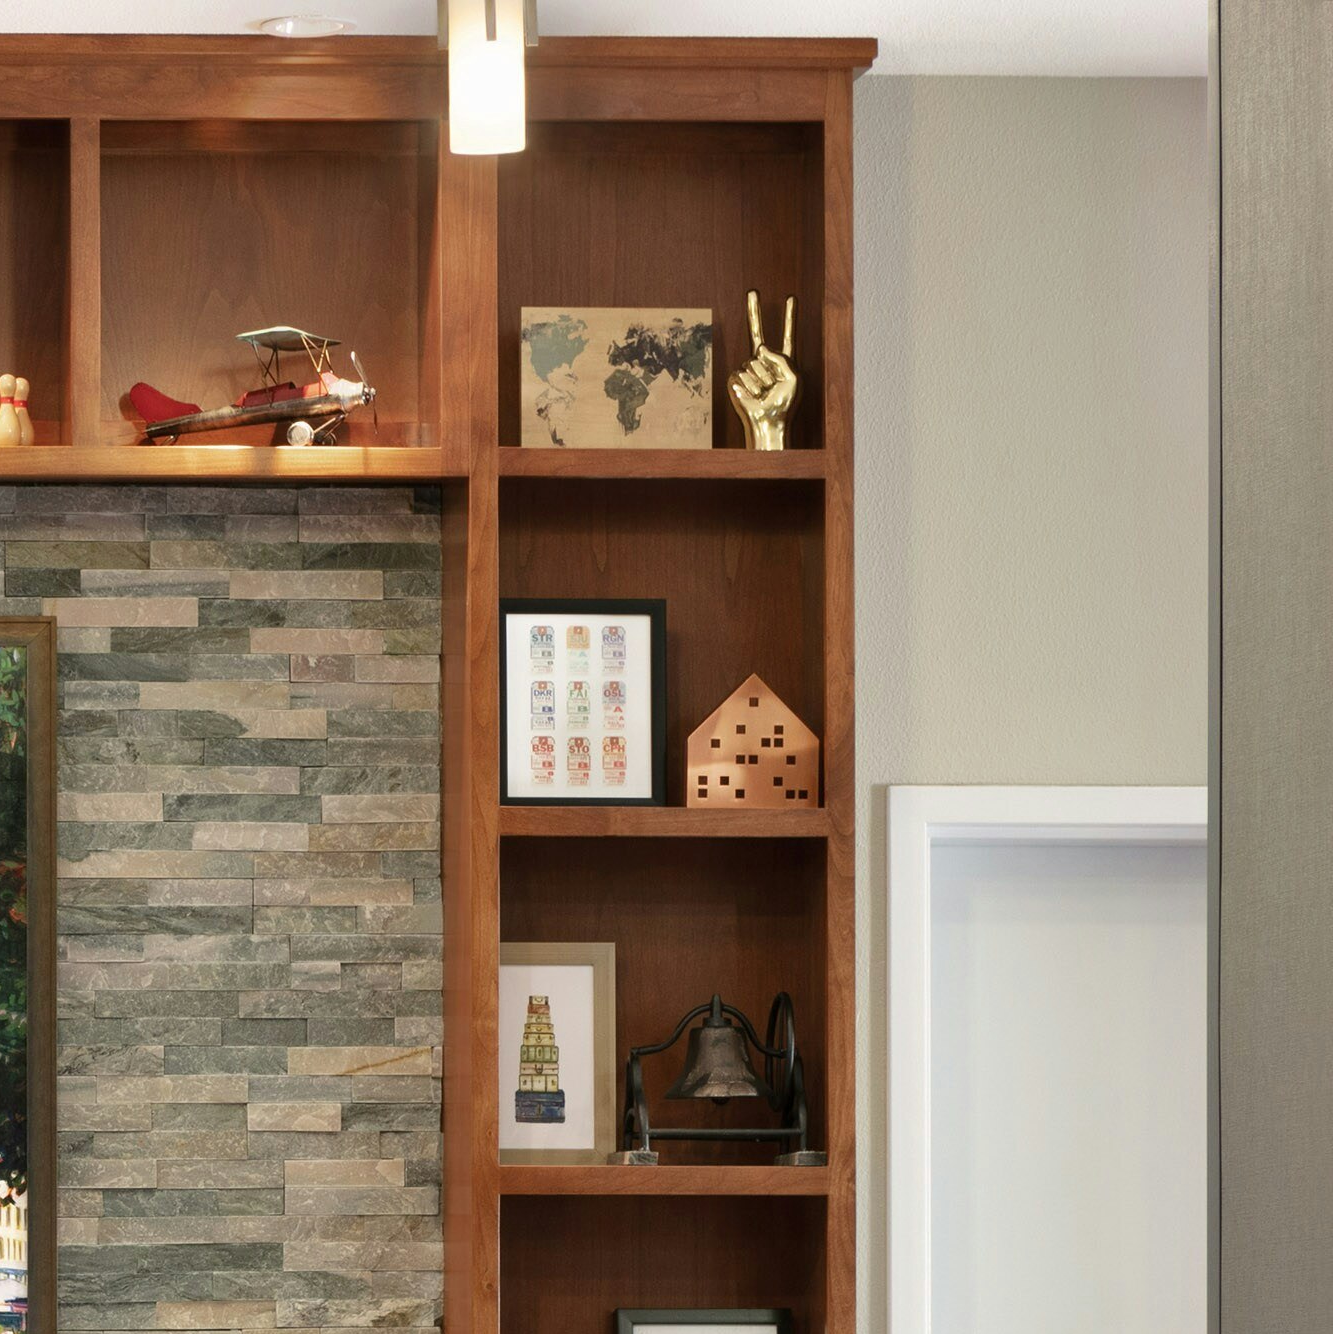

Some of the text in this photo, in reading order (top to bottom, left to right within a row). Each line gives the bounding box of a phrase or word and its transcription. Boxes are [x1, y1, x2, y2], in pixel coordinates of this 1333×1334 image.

[603, 689, 625, 698] OSL
[532, 744, 554, 752] BSB
[603, 744, 625, 752] CPH
